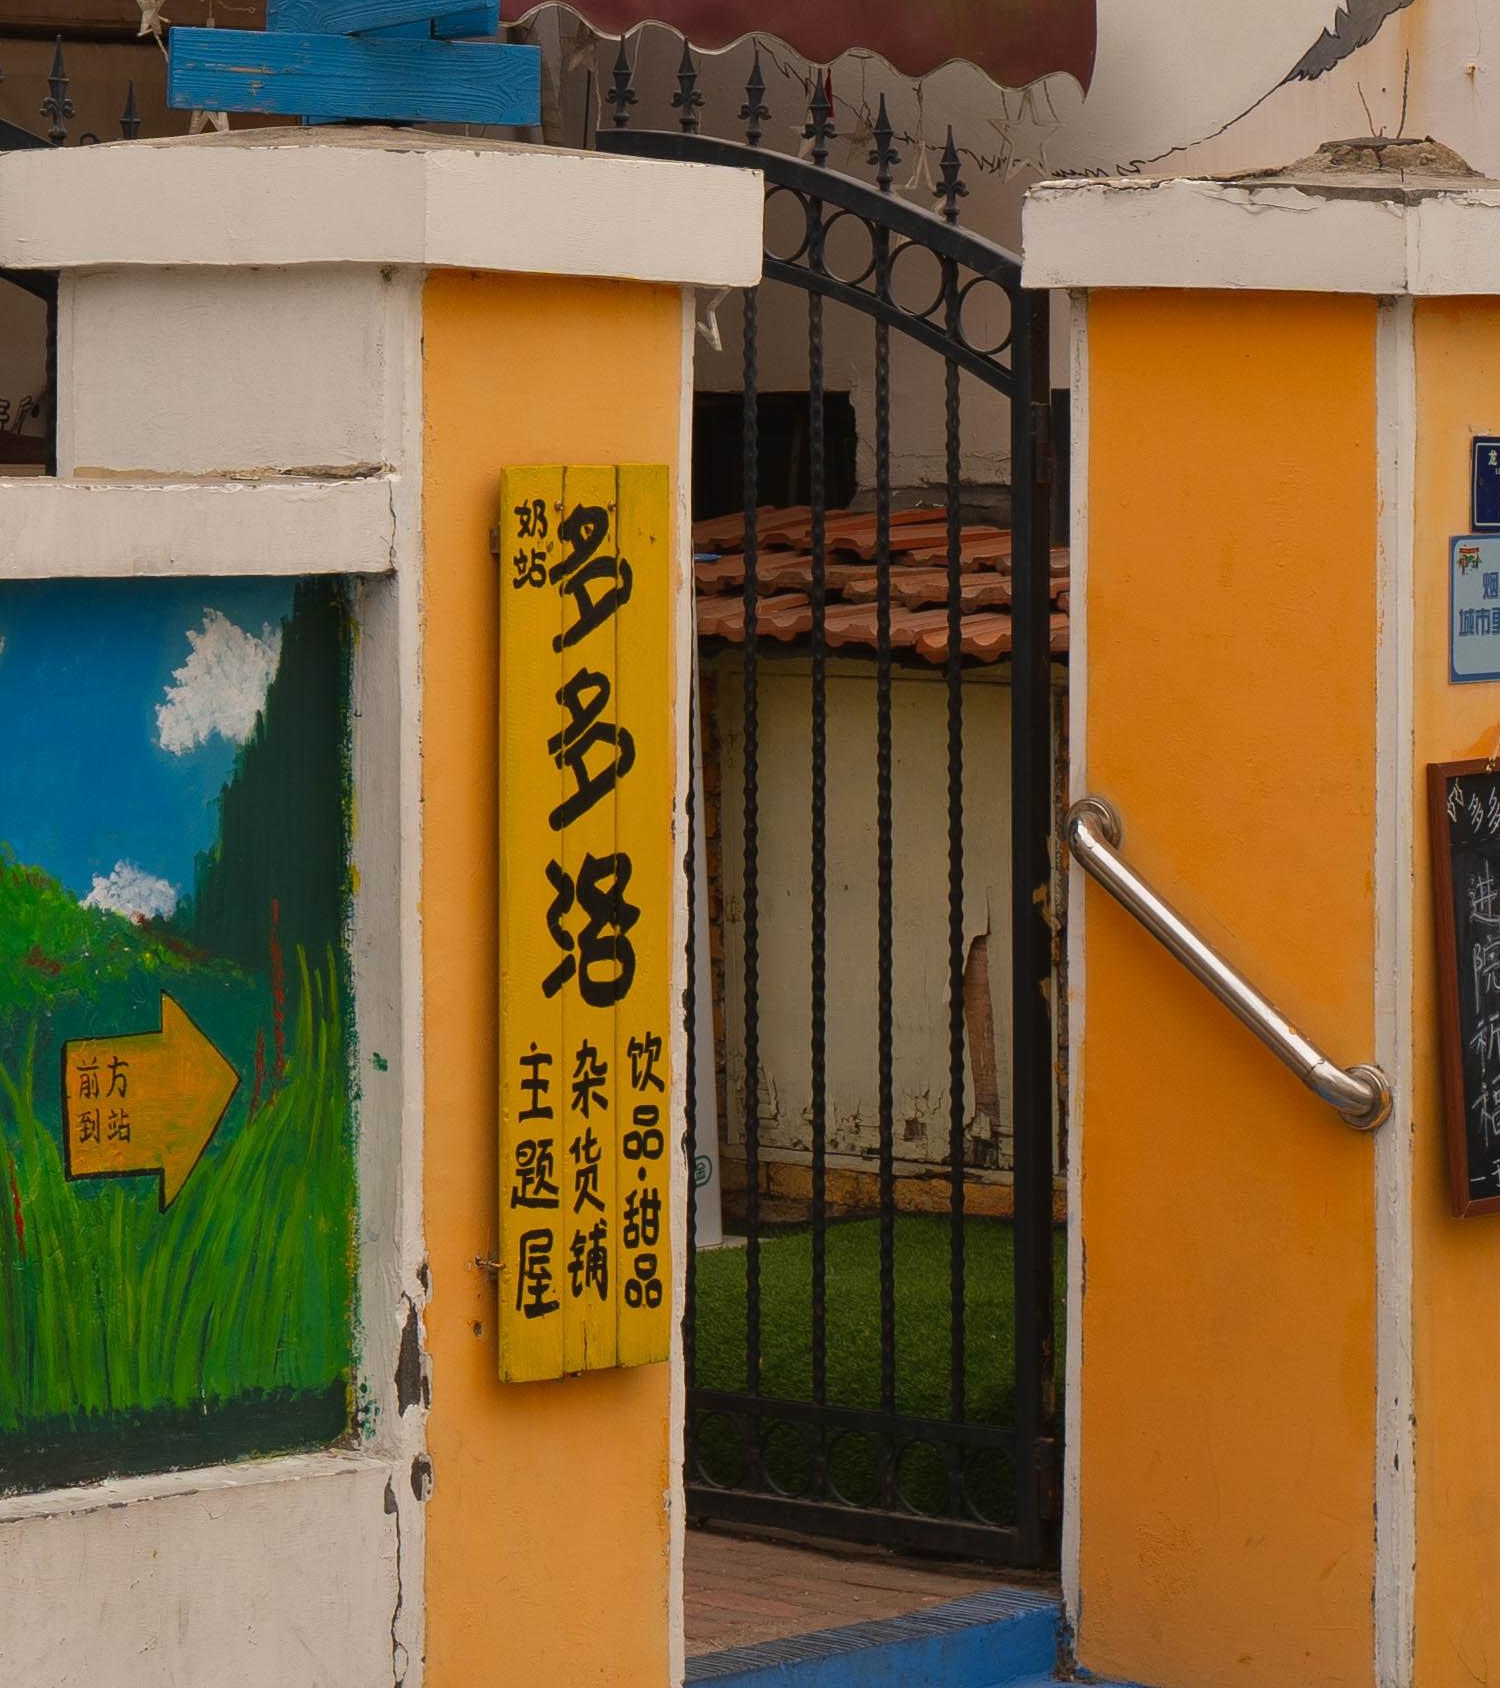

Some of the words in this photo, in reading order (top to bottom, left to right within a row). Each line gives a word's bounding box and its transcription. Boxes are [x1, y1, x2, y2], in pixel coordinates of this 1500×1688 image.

[512, 498, 547, 589] 奶站
[541, 502, 641, 1008] 多多洛
[76, 1056, 130, 1099] 前方
[79, 1109, 131, 1144] 到站
[510, 1041, 560, 1320] 主题屋
[567, 1038, 609, 1302] 杂货铺
